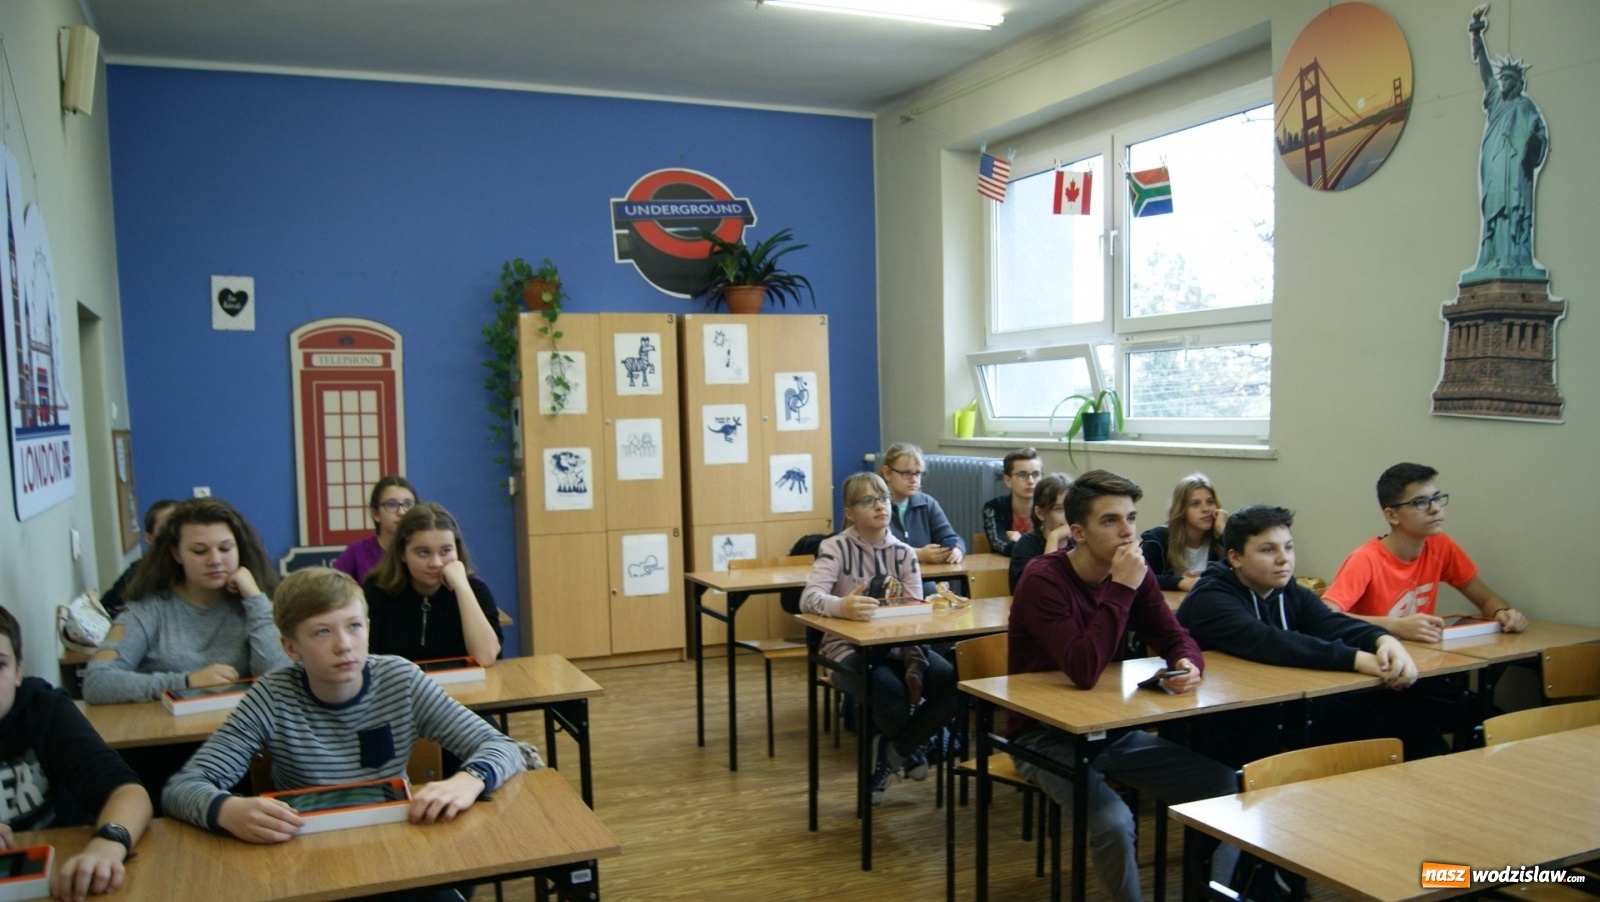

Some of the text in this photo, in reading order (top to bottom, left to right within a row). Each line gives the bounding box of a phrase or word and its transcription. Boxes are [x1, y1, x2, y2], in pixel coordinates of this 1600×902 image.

[624, 203, 743, 216] UNDERGROUND
[667, 313, 674, 325] 3
[819, 315, 827, 326] 2
[318, 355, 377, 365] TELEPHONE
[20, 441, 62, 494] LONDON
[826, 519, 832, 529] 7
[672, 527, 680, 538] 8
